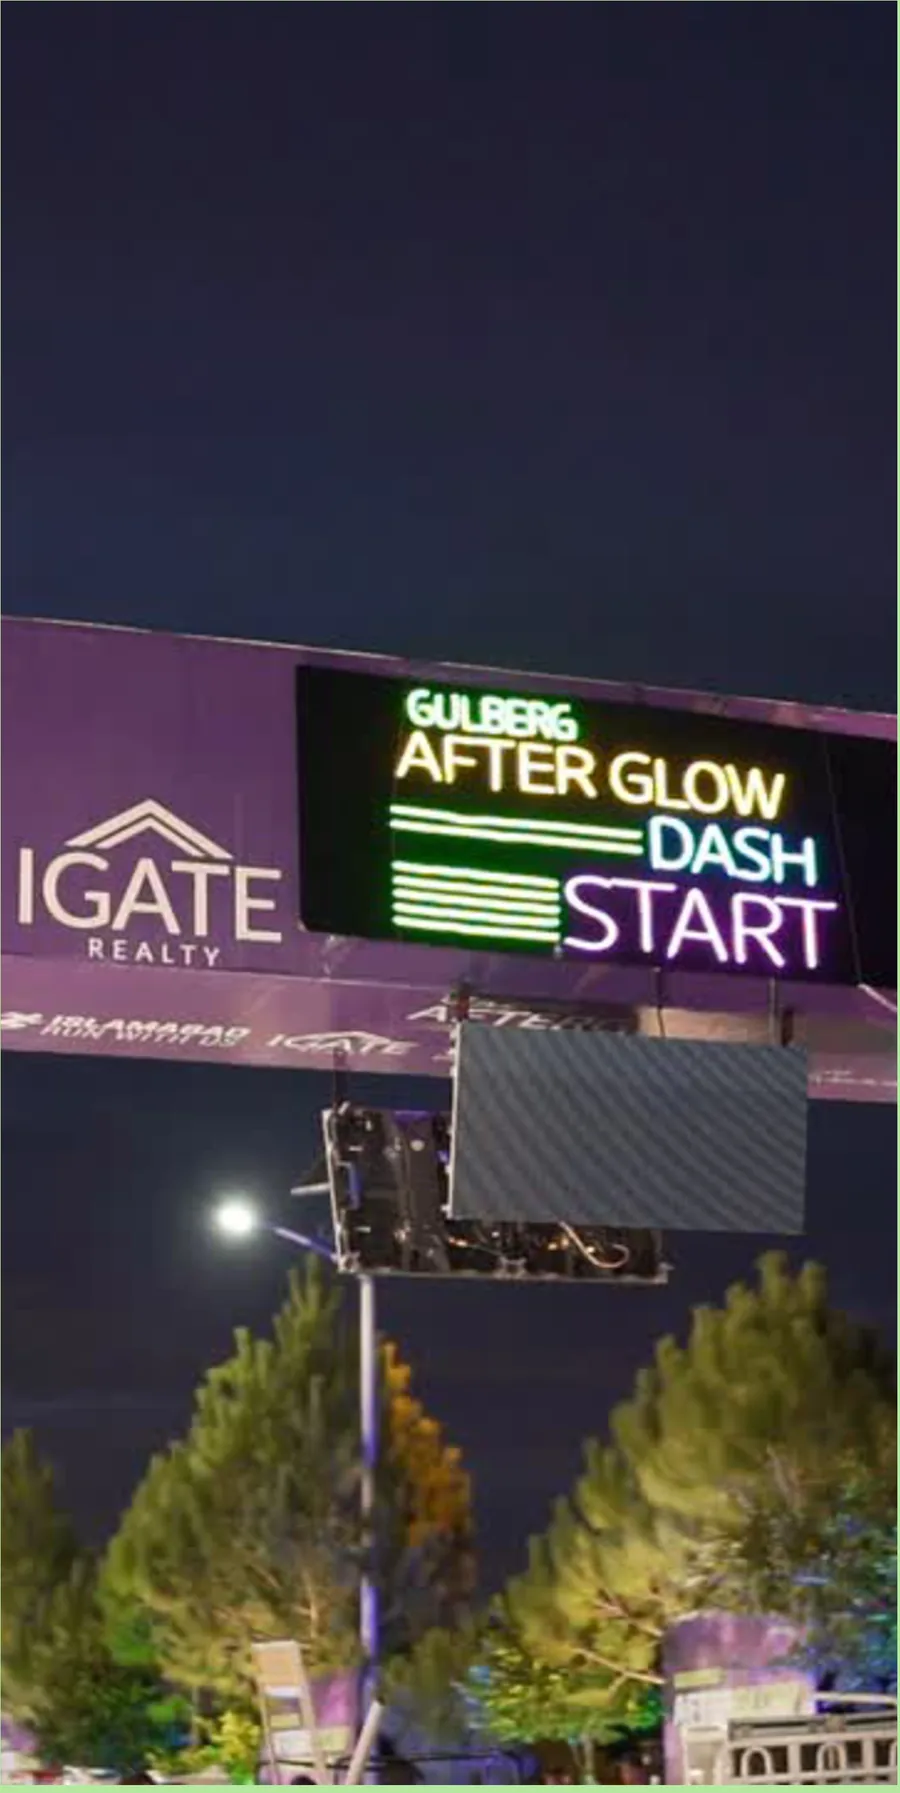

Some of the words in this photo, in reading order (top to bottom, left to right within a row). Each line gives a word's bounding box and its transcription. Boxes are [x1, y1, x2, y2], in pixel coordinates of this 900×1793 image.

[406, 687, 579, 742] GULBERG
[395, 730, 598, 799] AFTER
[609, 753, 785, 820] GLOW
[648, 815, 817, 888] DASH
[18, 846, 283, 944] IGATE
[564, 875, 837, 970] START
[88, 937, 221, 967] REALTY
[266, 1034, 421, 1056] IGATE
